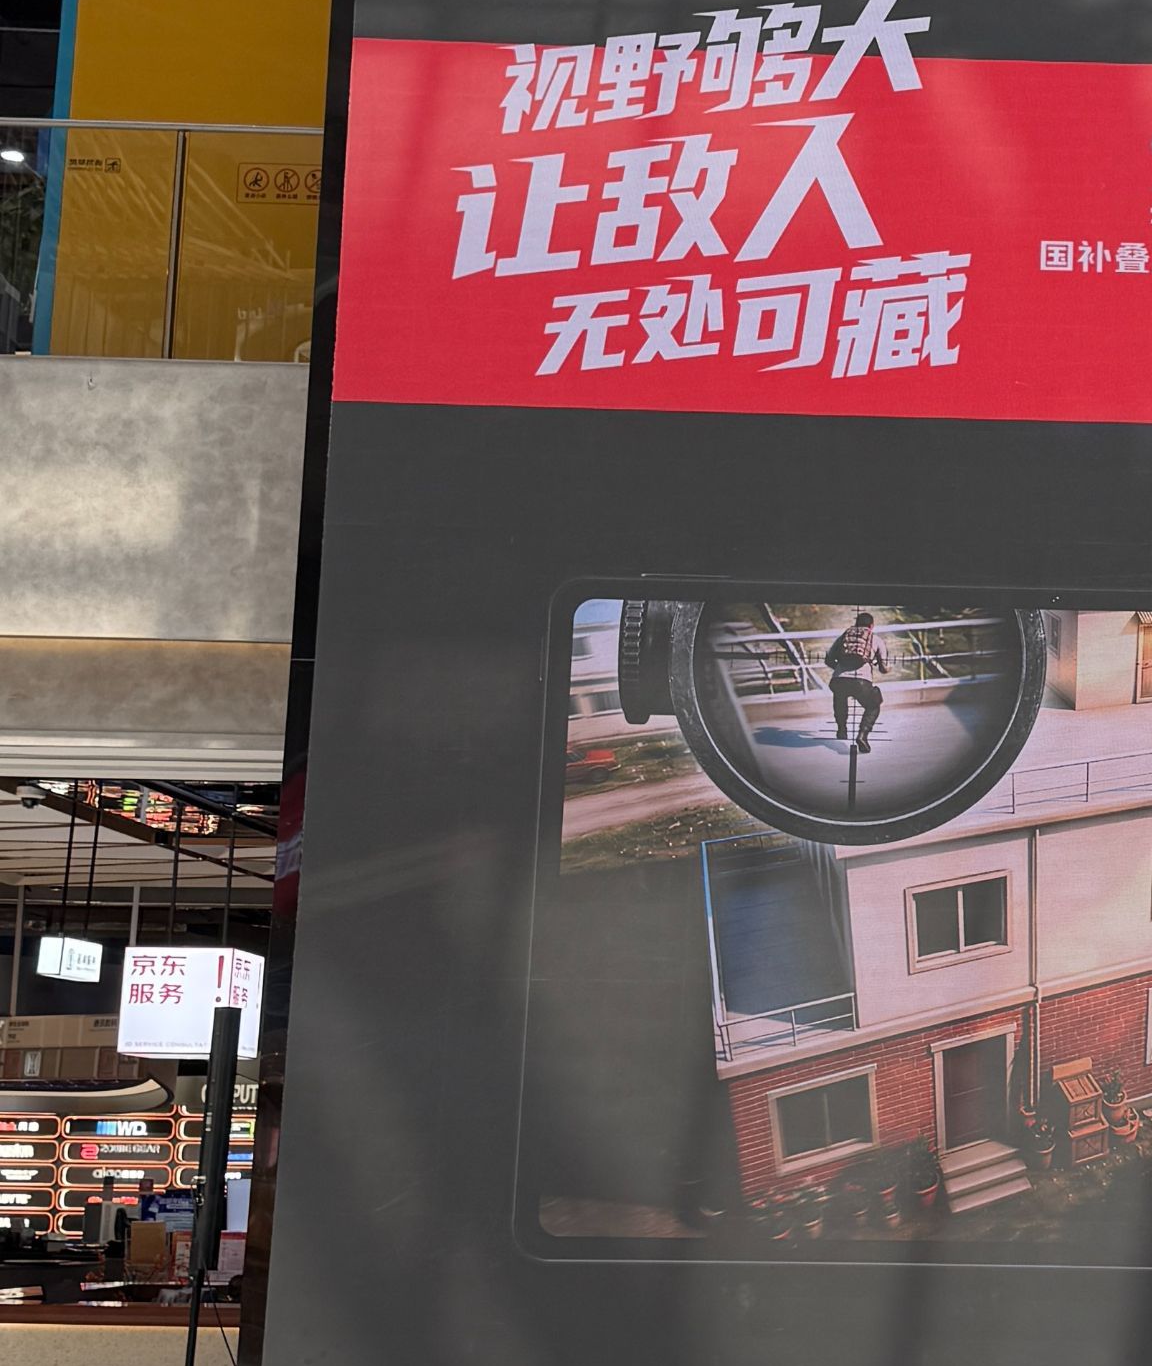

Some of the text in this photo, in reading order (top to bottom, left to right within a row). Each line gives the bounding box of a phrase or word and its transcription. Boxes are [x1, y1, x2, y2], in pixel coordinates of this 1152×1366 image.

[450, 113, 884, 280] 让敌人
[534, 250, 972, 380] 无处可藏
[128, 983, 184, 1005] 服务
[130, 954, 187, 977] 京东
